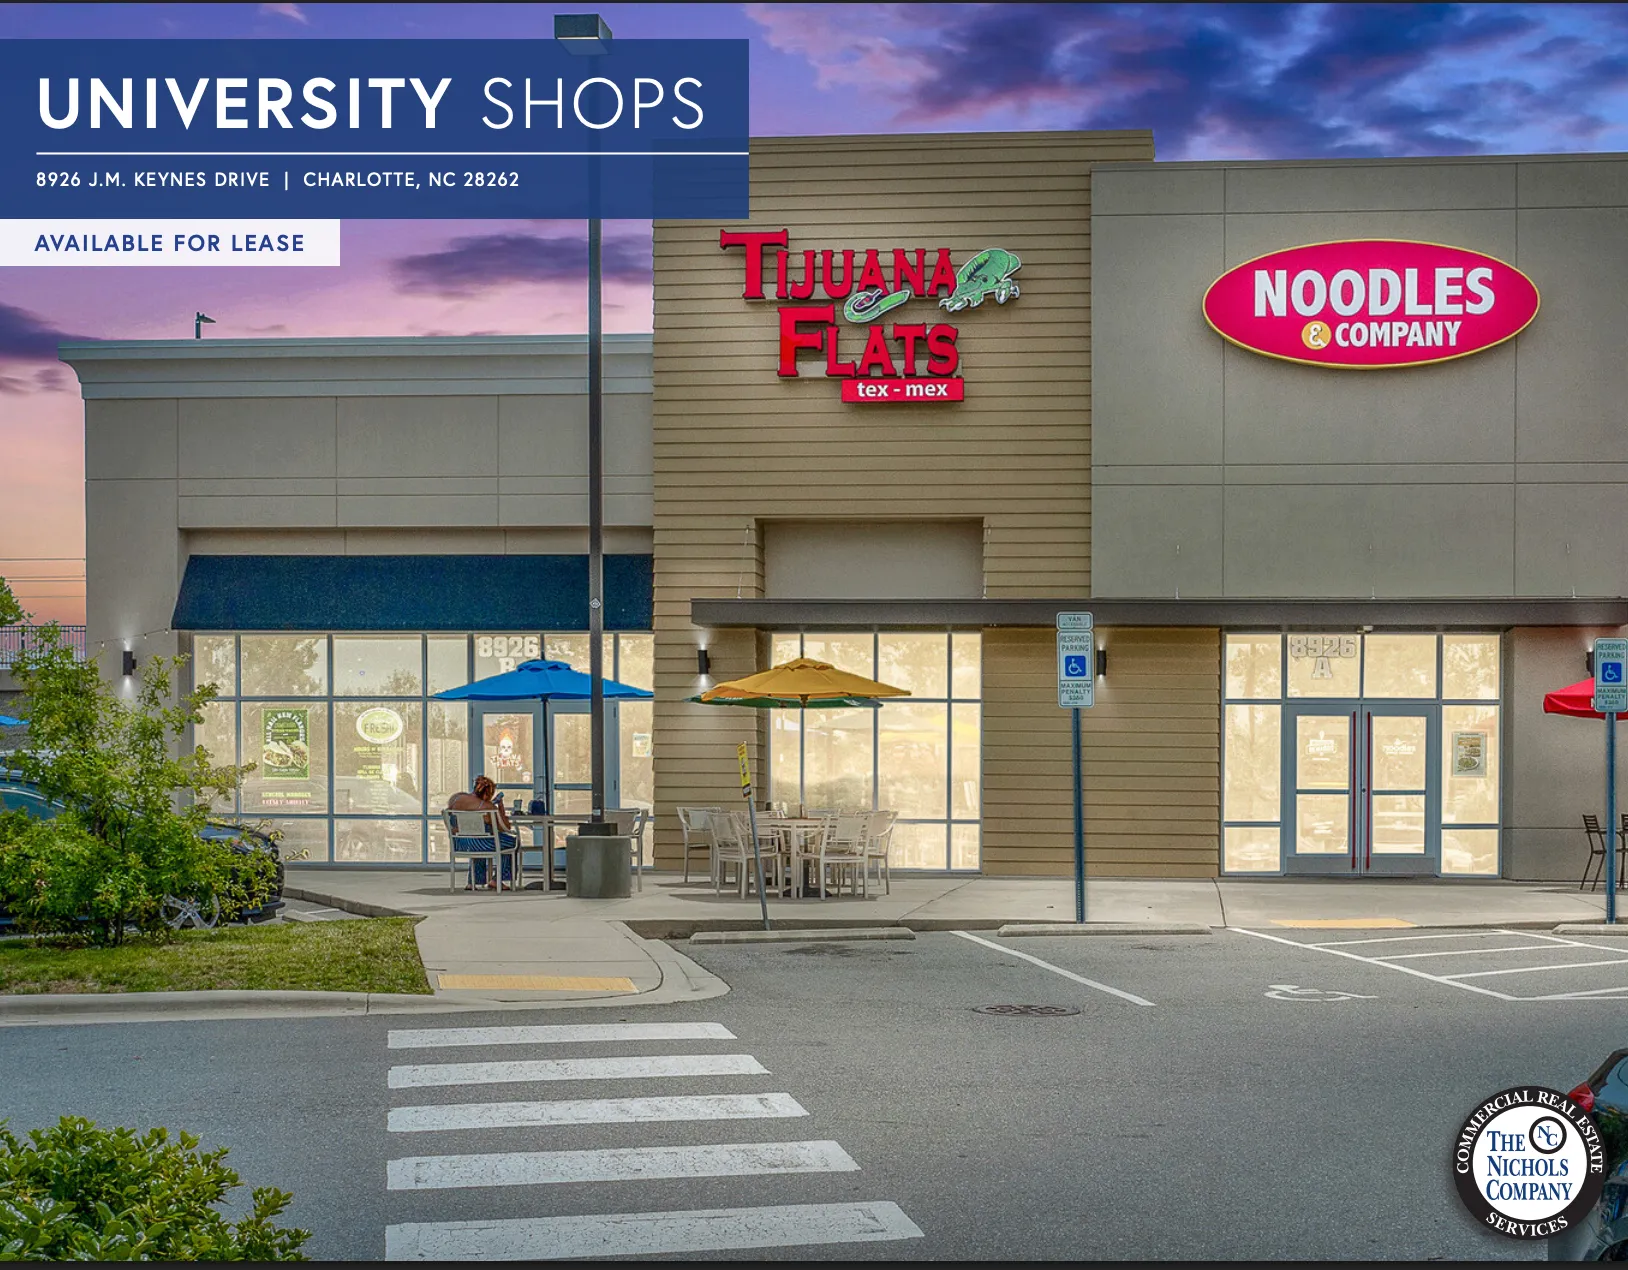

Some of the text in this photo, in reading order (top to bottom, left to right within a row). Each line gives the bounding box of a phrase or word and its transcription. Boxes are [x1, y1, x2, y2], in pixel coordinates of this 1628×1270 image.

[720, 228, 958, 301] TIJUANA
[1253, 267, 1496, 318] NOODLES
[777, 303, 960, 378] FLATS
[1335, 321, 1462, 347] COMPANY
[857, 382, 889, 397] tex
[905, 384, 948, 397] mex
[478, 636, 539, 658] 8926
[1061, 644, 1090, 652] PARKING
[1291, 636, 1357, 658] 8926
[1598, 651, 1626, 659] PARKING
[1310, 656, 1333, 679] A
